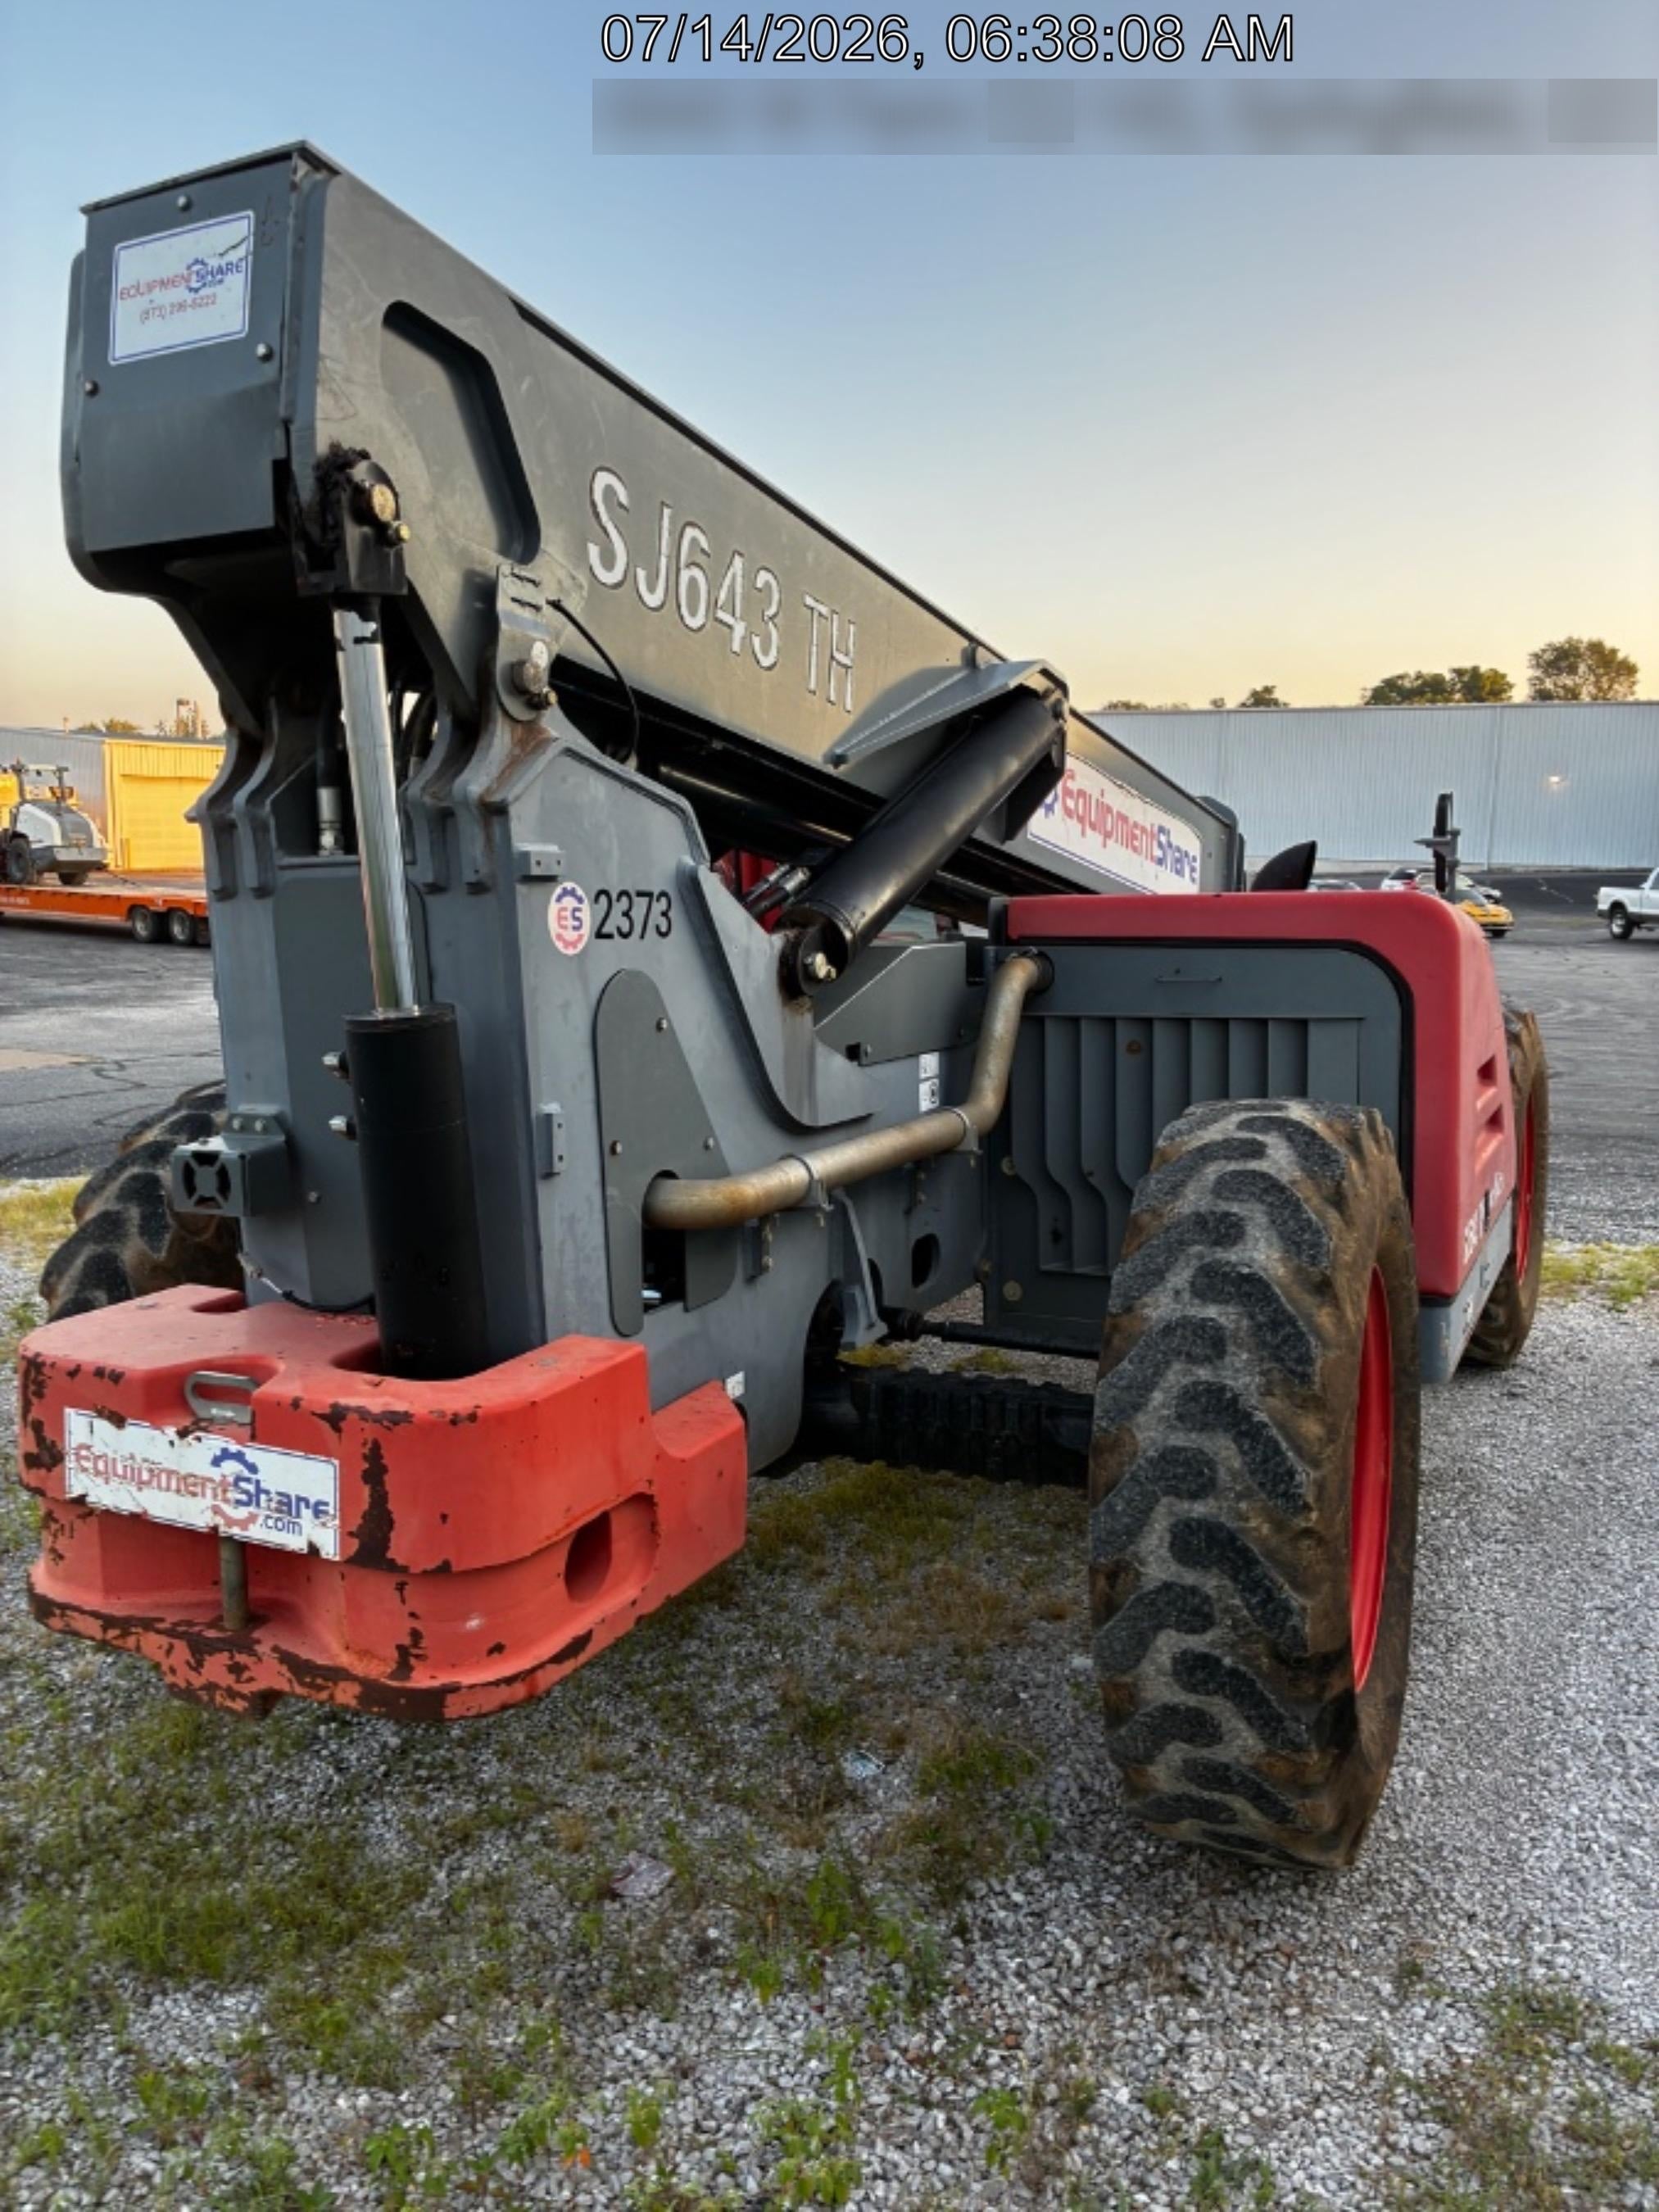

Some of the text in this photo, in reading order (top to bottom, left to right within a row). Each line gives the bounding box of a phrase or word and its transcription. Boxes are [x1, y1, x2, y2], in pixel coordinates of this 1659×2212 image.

[587, 466, 856, 714] SJ643 TH
[1061, 768, 1198, 885] EquipmentShare
[556, 906, 583, 931] ES
[594, 888, 673, 940] 2373
[74, 1443, 331, 1520] EquipmentShare
[260, 1515, 303, 1536] .com
